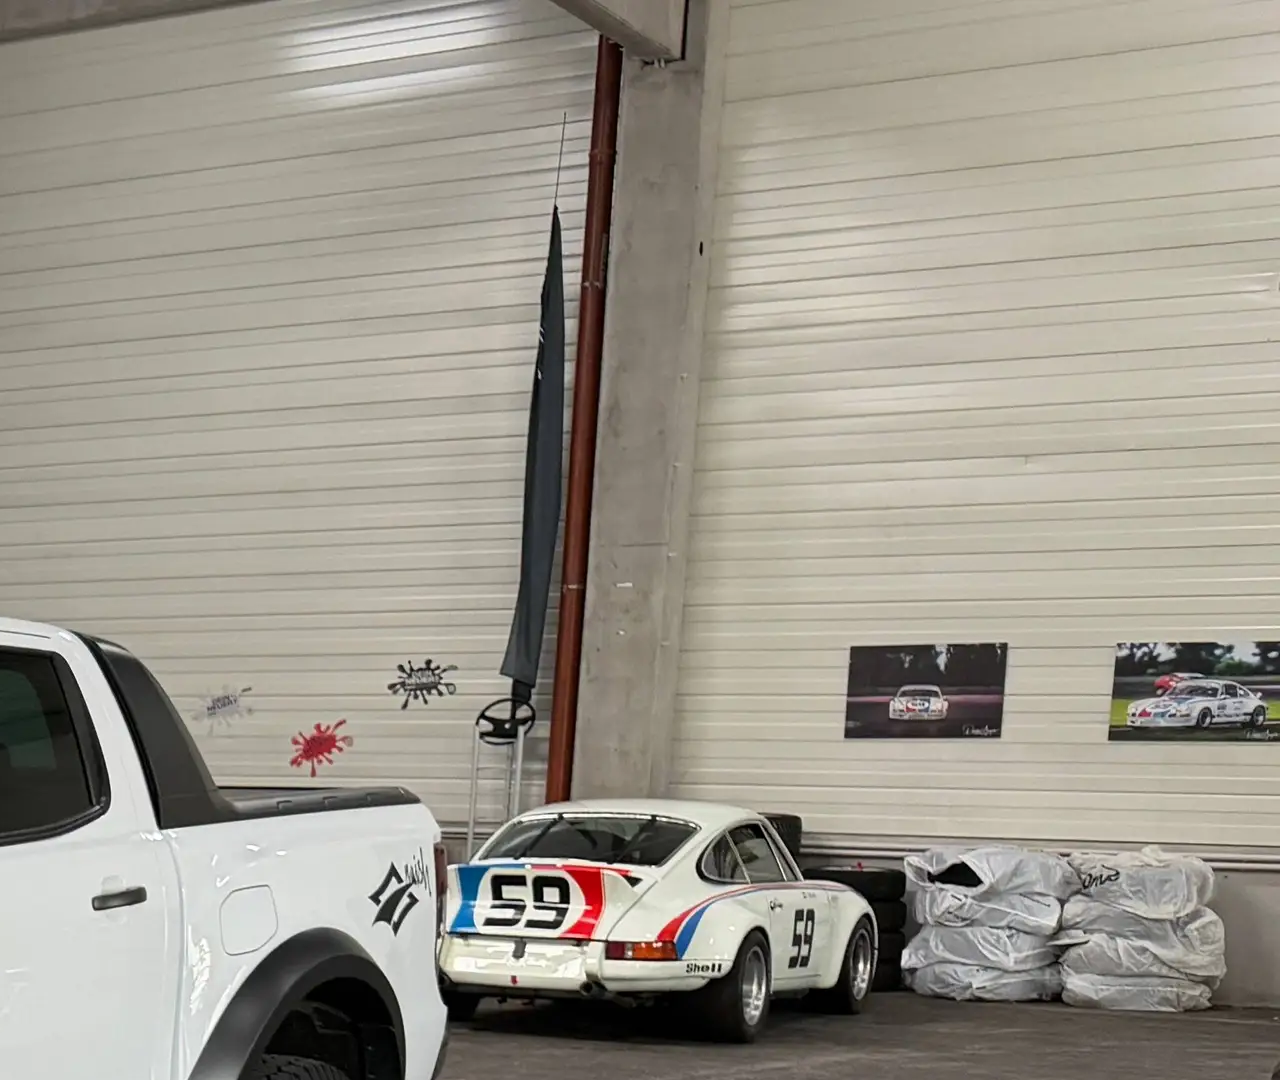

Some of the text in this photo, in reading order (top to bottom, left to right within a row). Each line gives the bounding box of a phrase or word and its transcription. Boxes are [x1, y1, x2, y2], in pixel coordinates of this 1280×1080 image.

[482, 874, 571, 930] 59
[788, 908, 816, 970] 59
[685, 962, 724, 974] Shell
